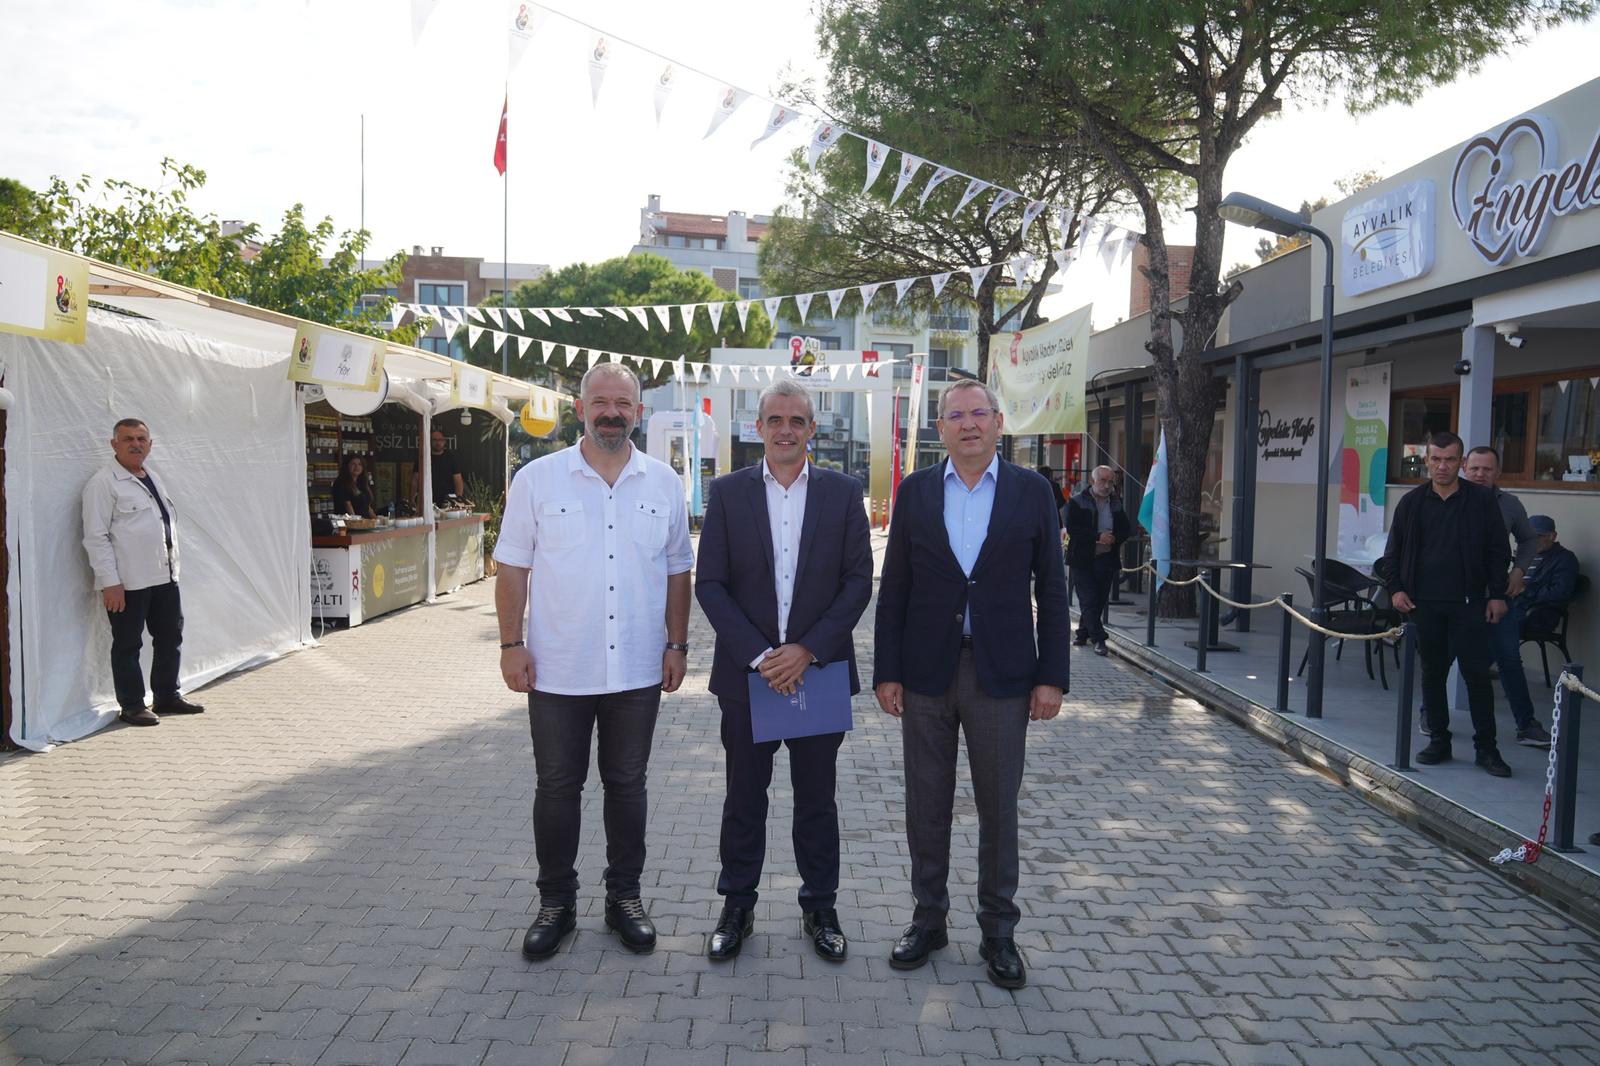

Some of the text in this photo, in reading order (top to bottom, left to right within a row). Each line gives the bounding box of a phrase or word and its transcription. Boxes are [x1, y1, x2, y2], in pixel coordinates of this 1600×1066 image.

[1353, 201, 1413, 239] AYVALIK
[375, 433, 404, 452] ŞSİZ
[313, 594, 343, 606] ALTI
